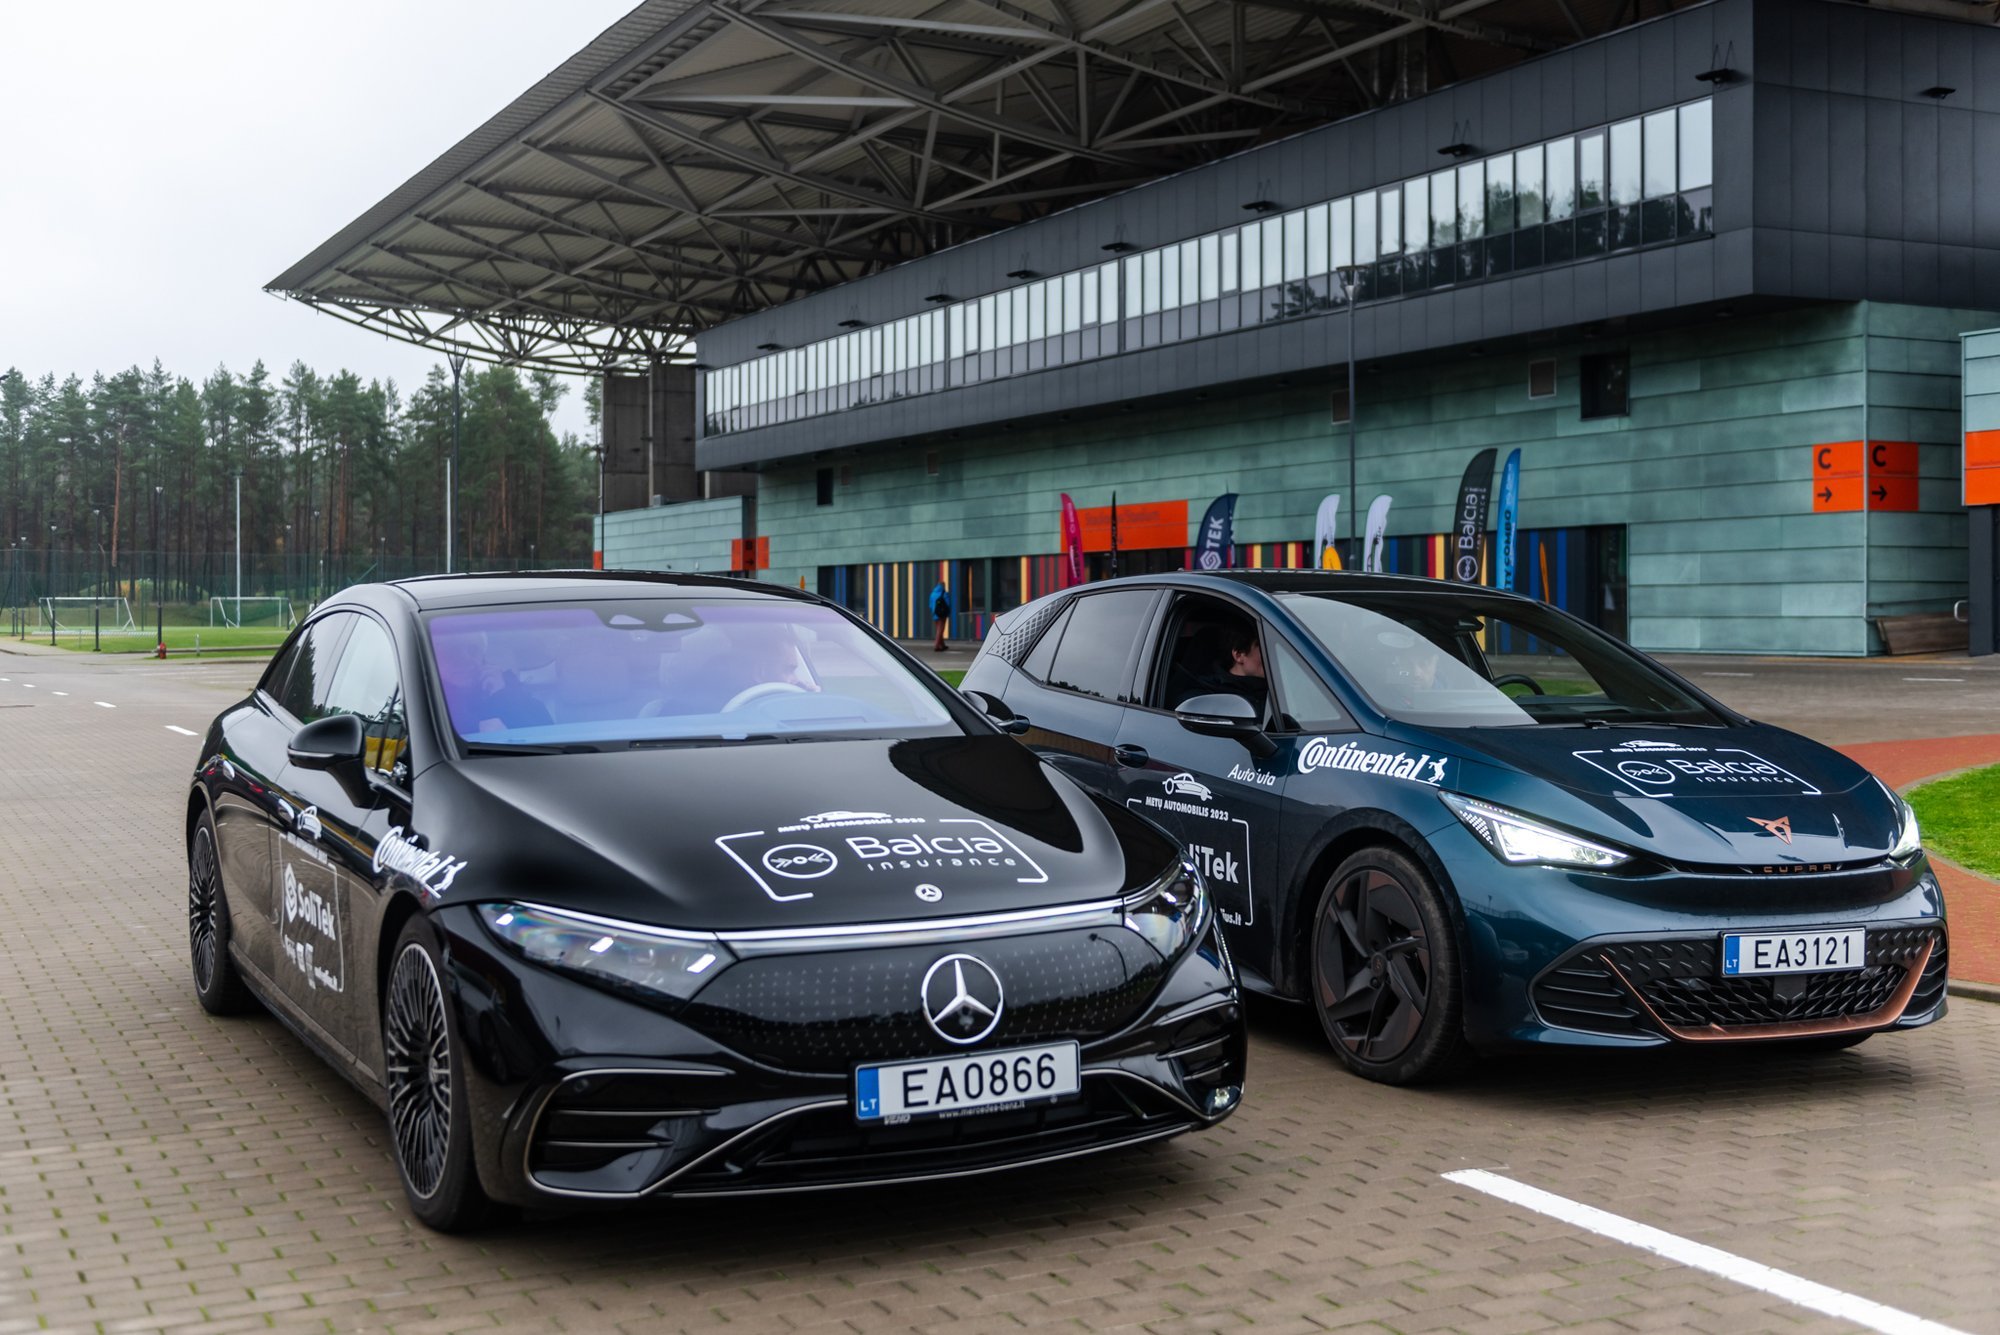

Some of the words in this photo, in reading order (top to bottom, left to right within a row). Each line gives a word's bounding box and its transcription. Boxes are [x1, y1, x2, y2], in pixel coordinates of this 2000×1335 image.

[1818, 448, 1832, 469] C
[1872, 445, 1886, 467] C
[1206, 516, 1224, 549] TEK
[1458, 493, 1478, 549] Balcia
[1297, 737, 1431, 781] Continental
[1665, 759, 1778, 775] Balcia
[1163, 800, 1209, 818] AUTOMOBILIS
[1210, 808, 1229, 821] 2023
[845, 834, 1004, 859] Balcia
[867, 857, 1017, 872] insurance
[1763, 864, 1832, 873] CUPRA
[1726, 958, 1738, 969] LT
[1754, 935, 1851, 969] EA3121
[860, 1098, 877, 1112] LT
[902, 1053, 1056, 1109] EA0866
